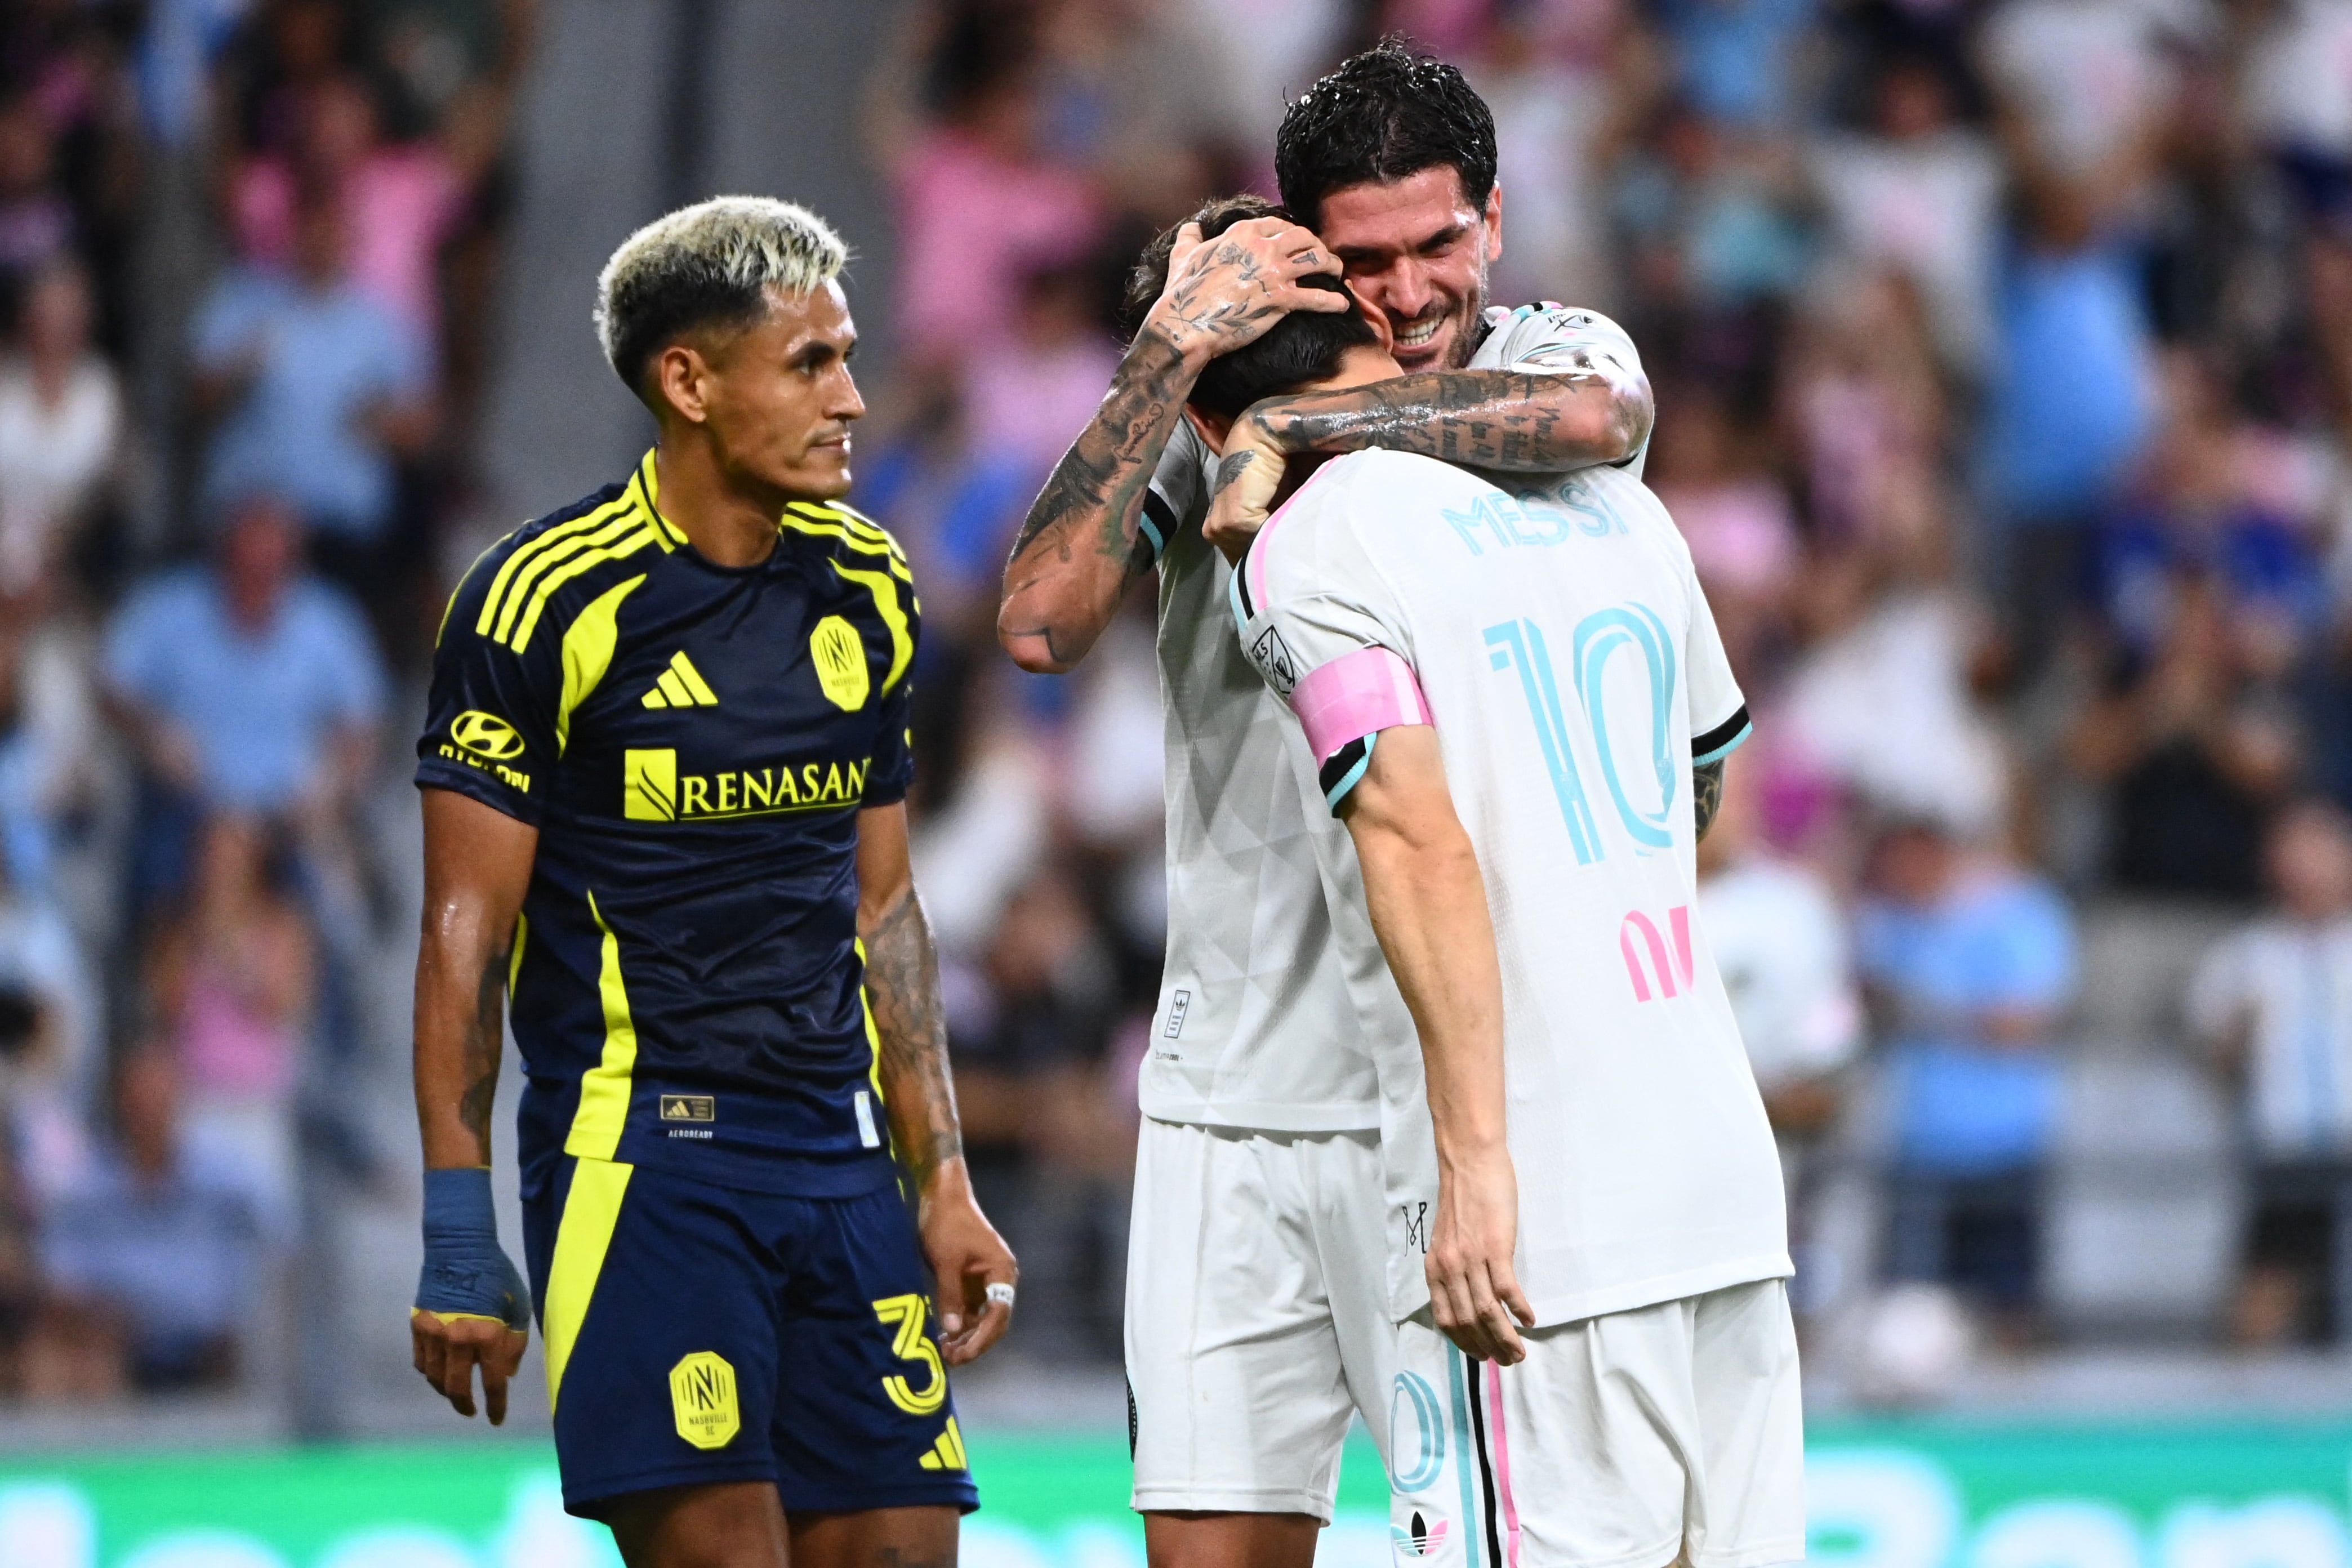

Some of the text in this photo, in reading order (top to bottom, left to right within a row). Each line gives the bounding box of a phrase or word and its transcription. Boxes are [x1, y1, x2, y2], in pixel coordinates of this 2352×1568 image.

[1440, 482, 1629, 556] MESSI
[1482, 600, 1676, 866] 10
[680, 756, 871, 814] RENASAN
[668, 1129, 713, 1138] AEROREADY
[872, 1293, 946, 1416] 3
[689, 1413, 728, 1425] NASHVILLE
